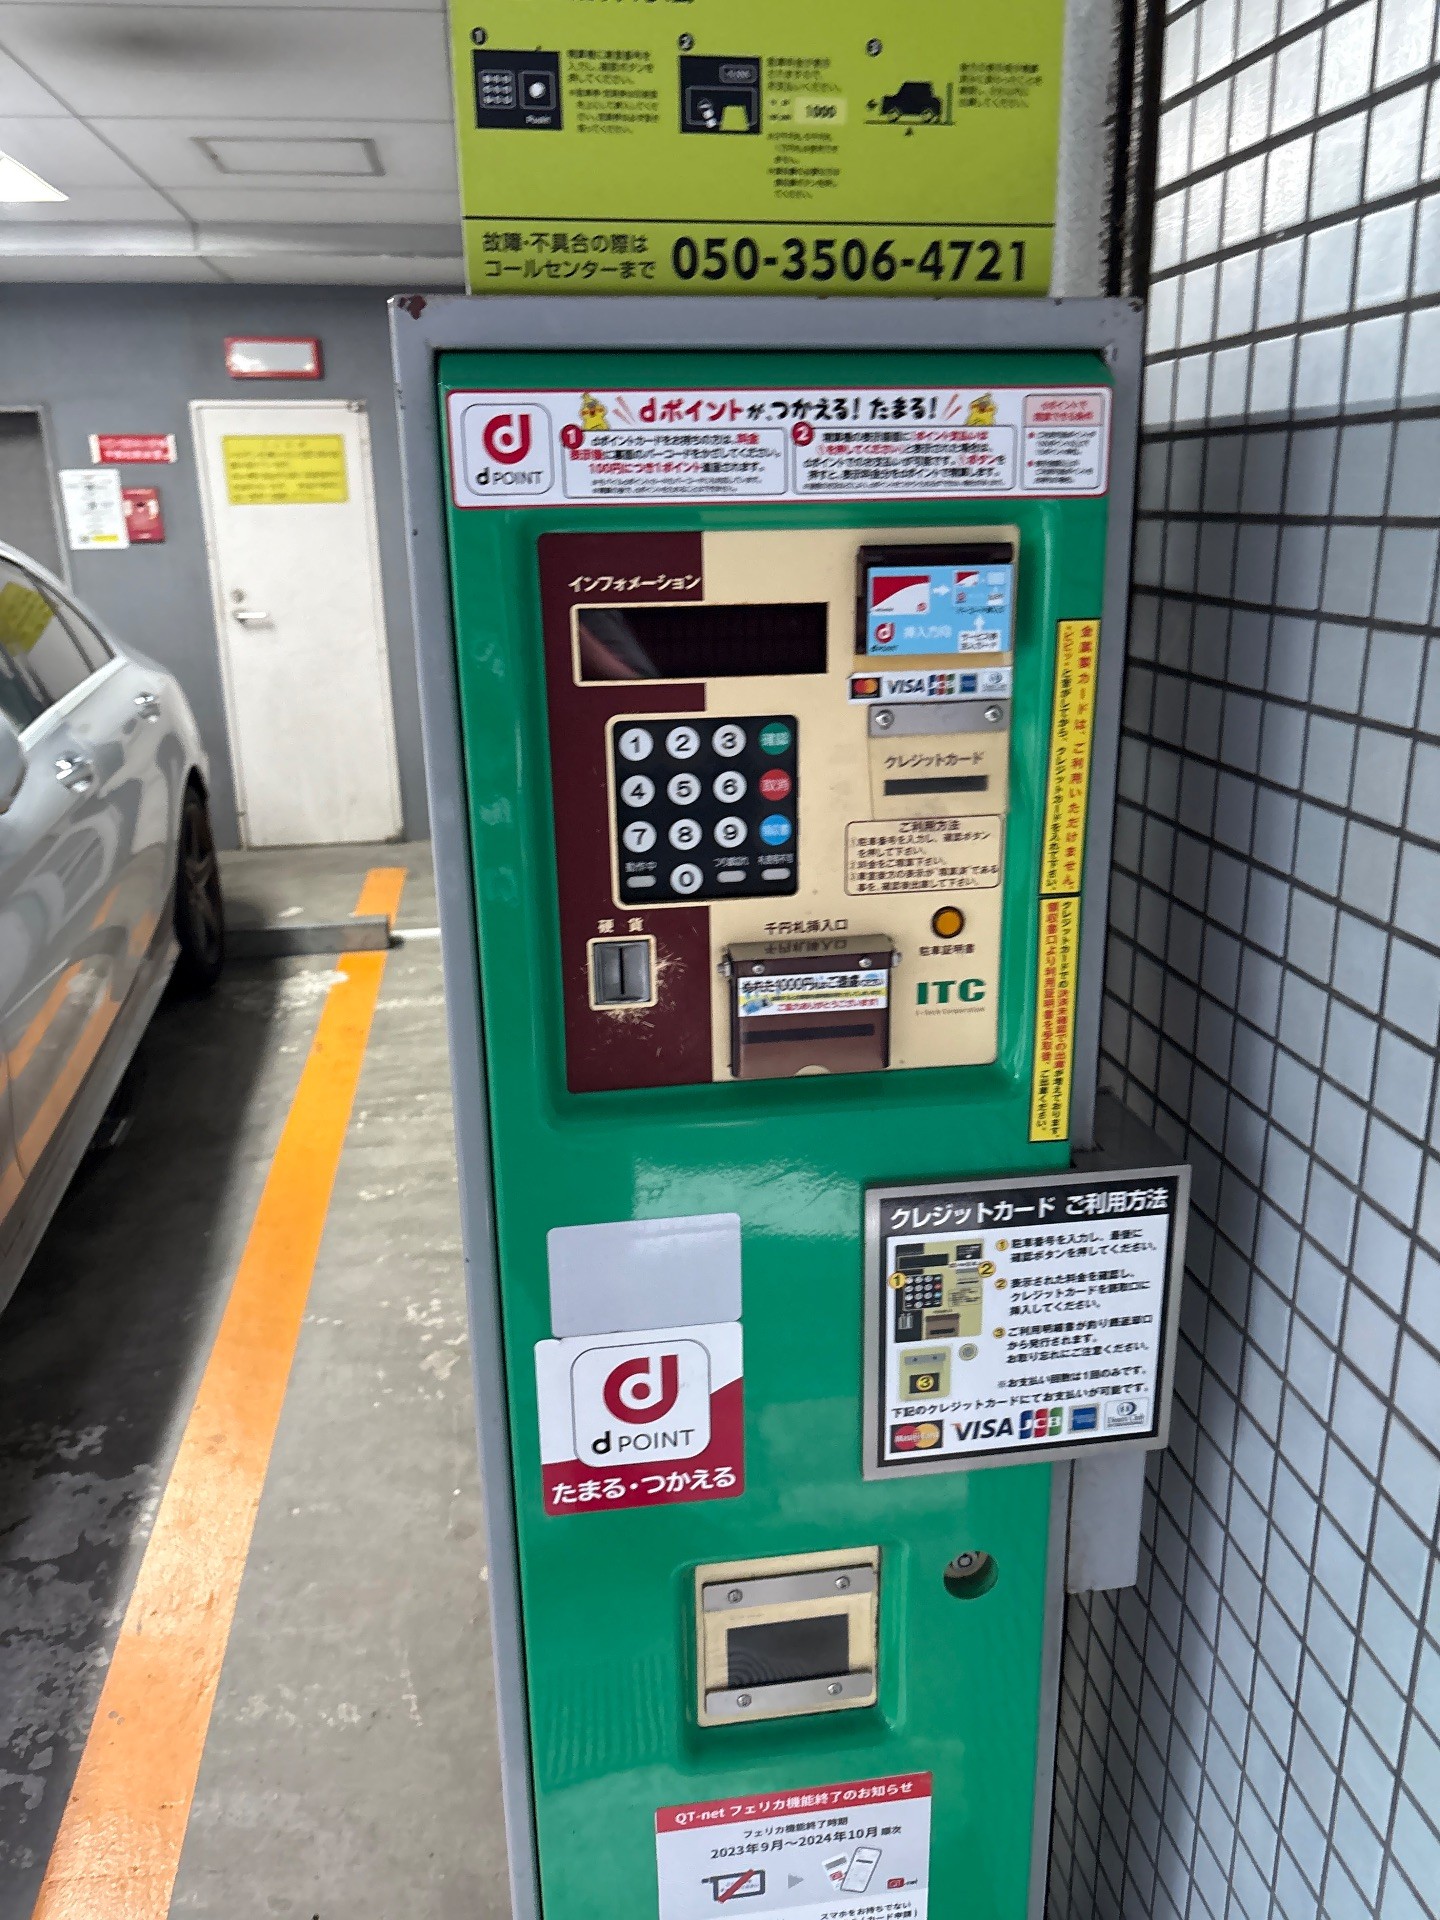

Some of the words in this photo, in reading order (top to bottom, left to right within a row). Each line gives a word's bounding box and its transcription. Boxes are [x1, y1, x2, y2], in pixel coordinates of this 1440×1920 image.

[806, 105, 837, 119] 1000
[482, 231, 648, 255] 故障・不具合の際は
[485, 258, 656, 281] コールセンターまで
[672, 235, 1027, 283] 050-3506-4721
[568, 574, 701, 593] インフォメーション
[887, 678, 926, 695] VISA
[629, 735, 641, 754] 1
[676, 734, 691, 752] 2
[721, 732, 737, 750] 3
[883, 751, 984, 769] クレジットカード
[629, 782, 645, 800] 4
[676, 780, 692, 798] 5
[722, 778, 738, 796] 6
[631, 828, 648, 846] 7
[678, 826, 693, 843] 8
[722, 824, 738, 841] 9
[898, 820, 961, 833] ご利用方法
[678, 871, 695, 888] 0
[764, 919, 848, 935] 千円札挿入口
[919, 943, 975, 956] 駐車証明書
[917, 978, 986, 1006] ITC
[890, 1196, 1056, 1229] クレジットカード
[1065, 1187, 1169, 1215] ご利用方法
[1010, 1242, 1157, 1263] 確認ボタンを押してください。
[980, 1262, 994, 1276] 2
[1010, 1269, 1135, 1289] 表示された料金を確認し、
[1009, 1300, 1101, 1316] 挿入してください。
[1006, 1334, 1097, 1351] から発行されます。
[1005, 1343, 1149, 1364] お取り忘れにご注意ください。
[919, 1376, 932, 1389] 3
[892, 1383, 1149, 1418] 下記のクレジットカードにてお支払いが可能です。
[951, 1417, 1014, 1441] VISA
[1019, 1406, 1064, 1440] JCB
[619, 1428, 695, 1453] POINT
[552, 1467, 736, 1505] たまる・つかえる
[674, 1808, 726, 1825] QT-net
[730, 1782, 914, 1817] フェリカ機能終了のお知らせ
[743, 1817, 849, 1839] フェリカ機能終了時期
[880, 1824, 902, 1836] 順次
[820, 1901, 912, 1920] スマホをお持ちでない
